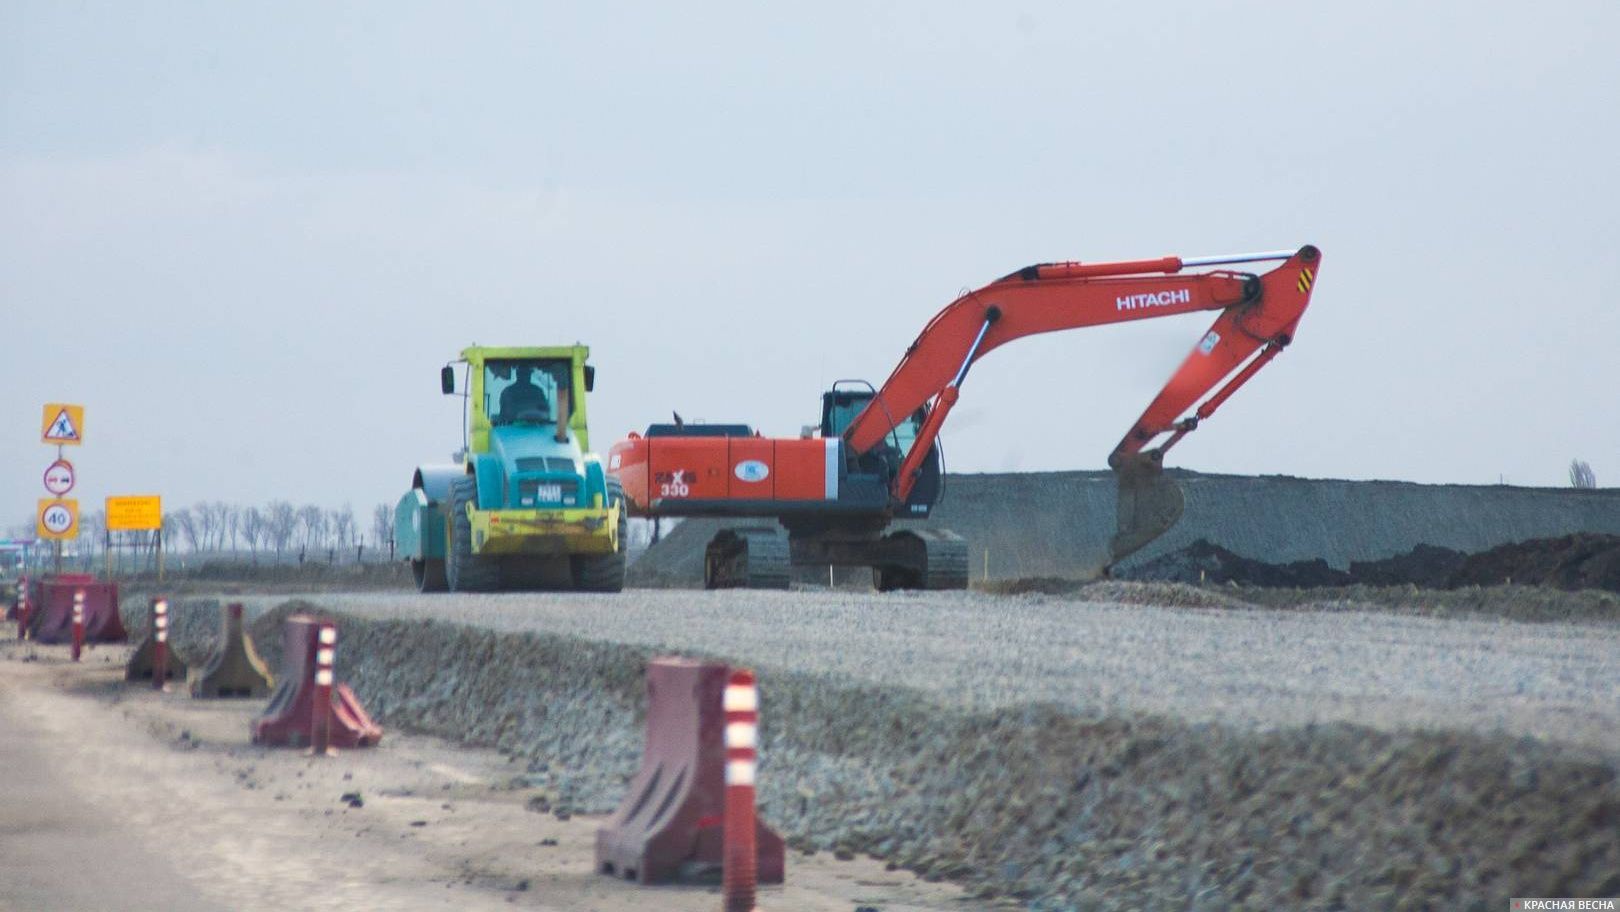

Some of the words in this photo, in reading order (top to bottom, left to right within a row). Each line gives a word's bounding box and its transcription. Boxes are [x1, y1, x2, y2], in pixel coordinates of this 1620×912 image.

[1116, 290, 1190, 311] HITACHI
[661, 483, 689, 497] 330
[48, 512, 65, 525] 40
